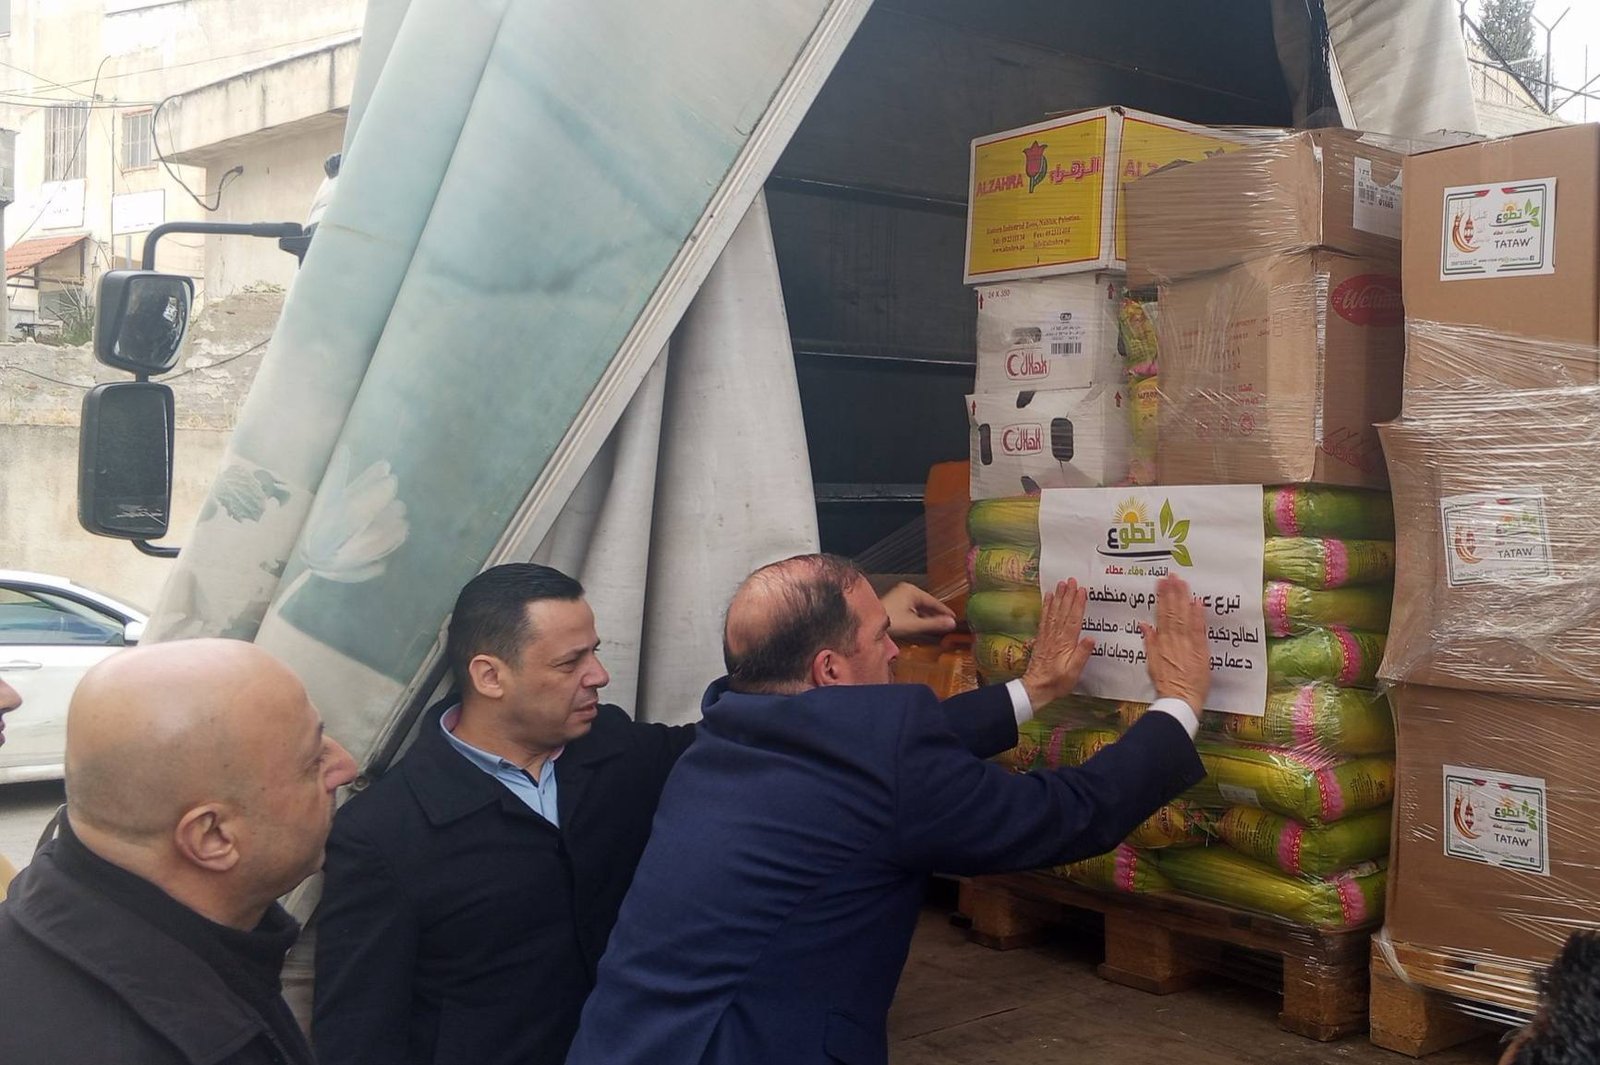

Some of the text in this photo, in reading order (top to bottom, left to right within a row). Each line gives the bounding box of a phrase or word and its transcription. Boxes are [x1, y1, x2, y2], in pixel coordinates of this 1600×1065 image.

[975, 173, 1024, 197] ALZAHRA
[1107, 521, 1155, 549] تطوع
[1105, 565, 1123, 575] عطاء
[1088, 585, 1127, 603] منظمة
[1129, 592, 1145, 608] من
[1215, 595, 1240, 615] تبرع
[1081, 616, 1118, 632] محافظة
[1208, 626, 1230, 643] تكية
[1231, 626, 1258, 647] لصالح
[1107, 642, 1134, 663] وجبات
[1224, 652, 1252, 669] دعما
